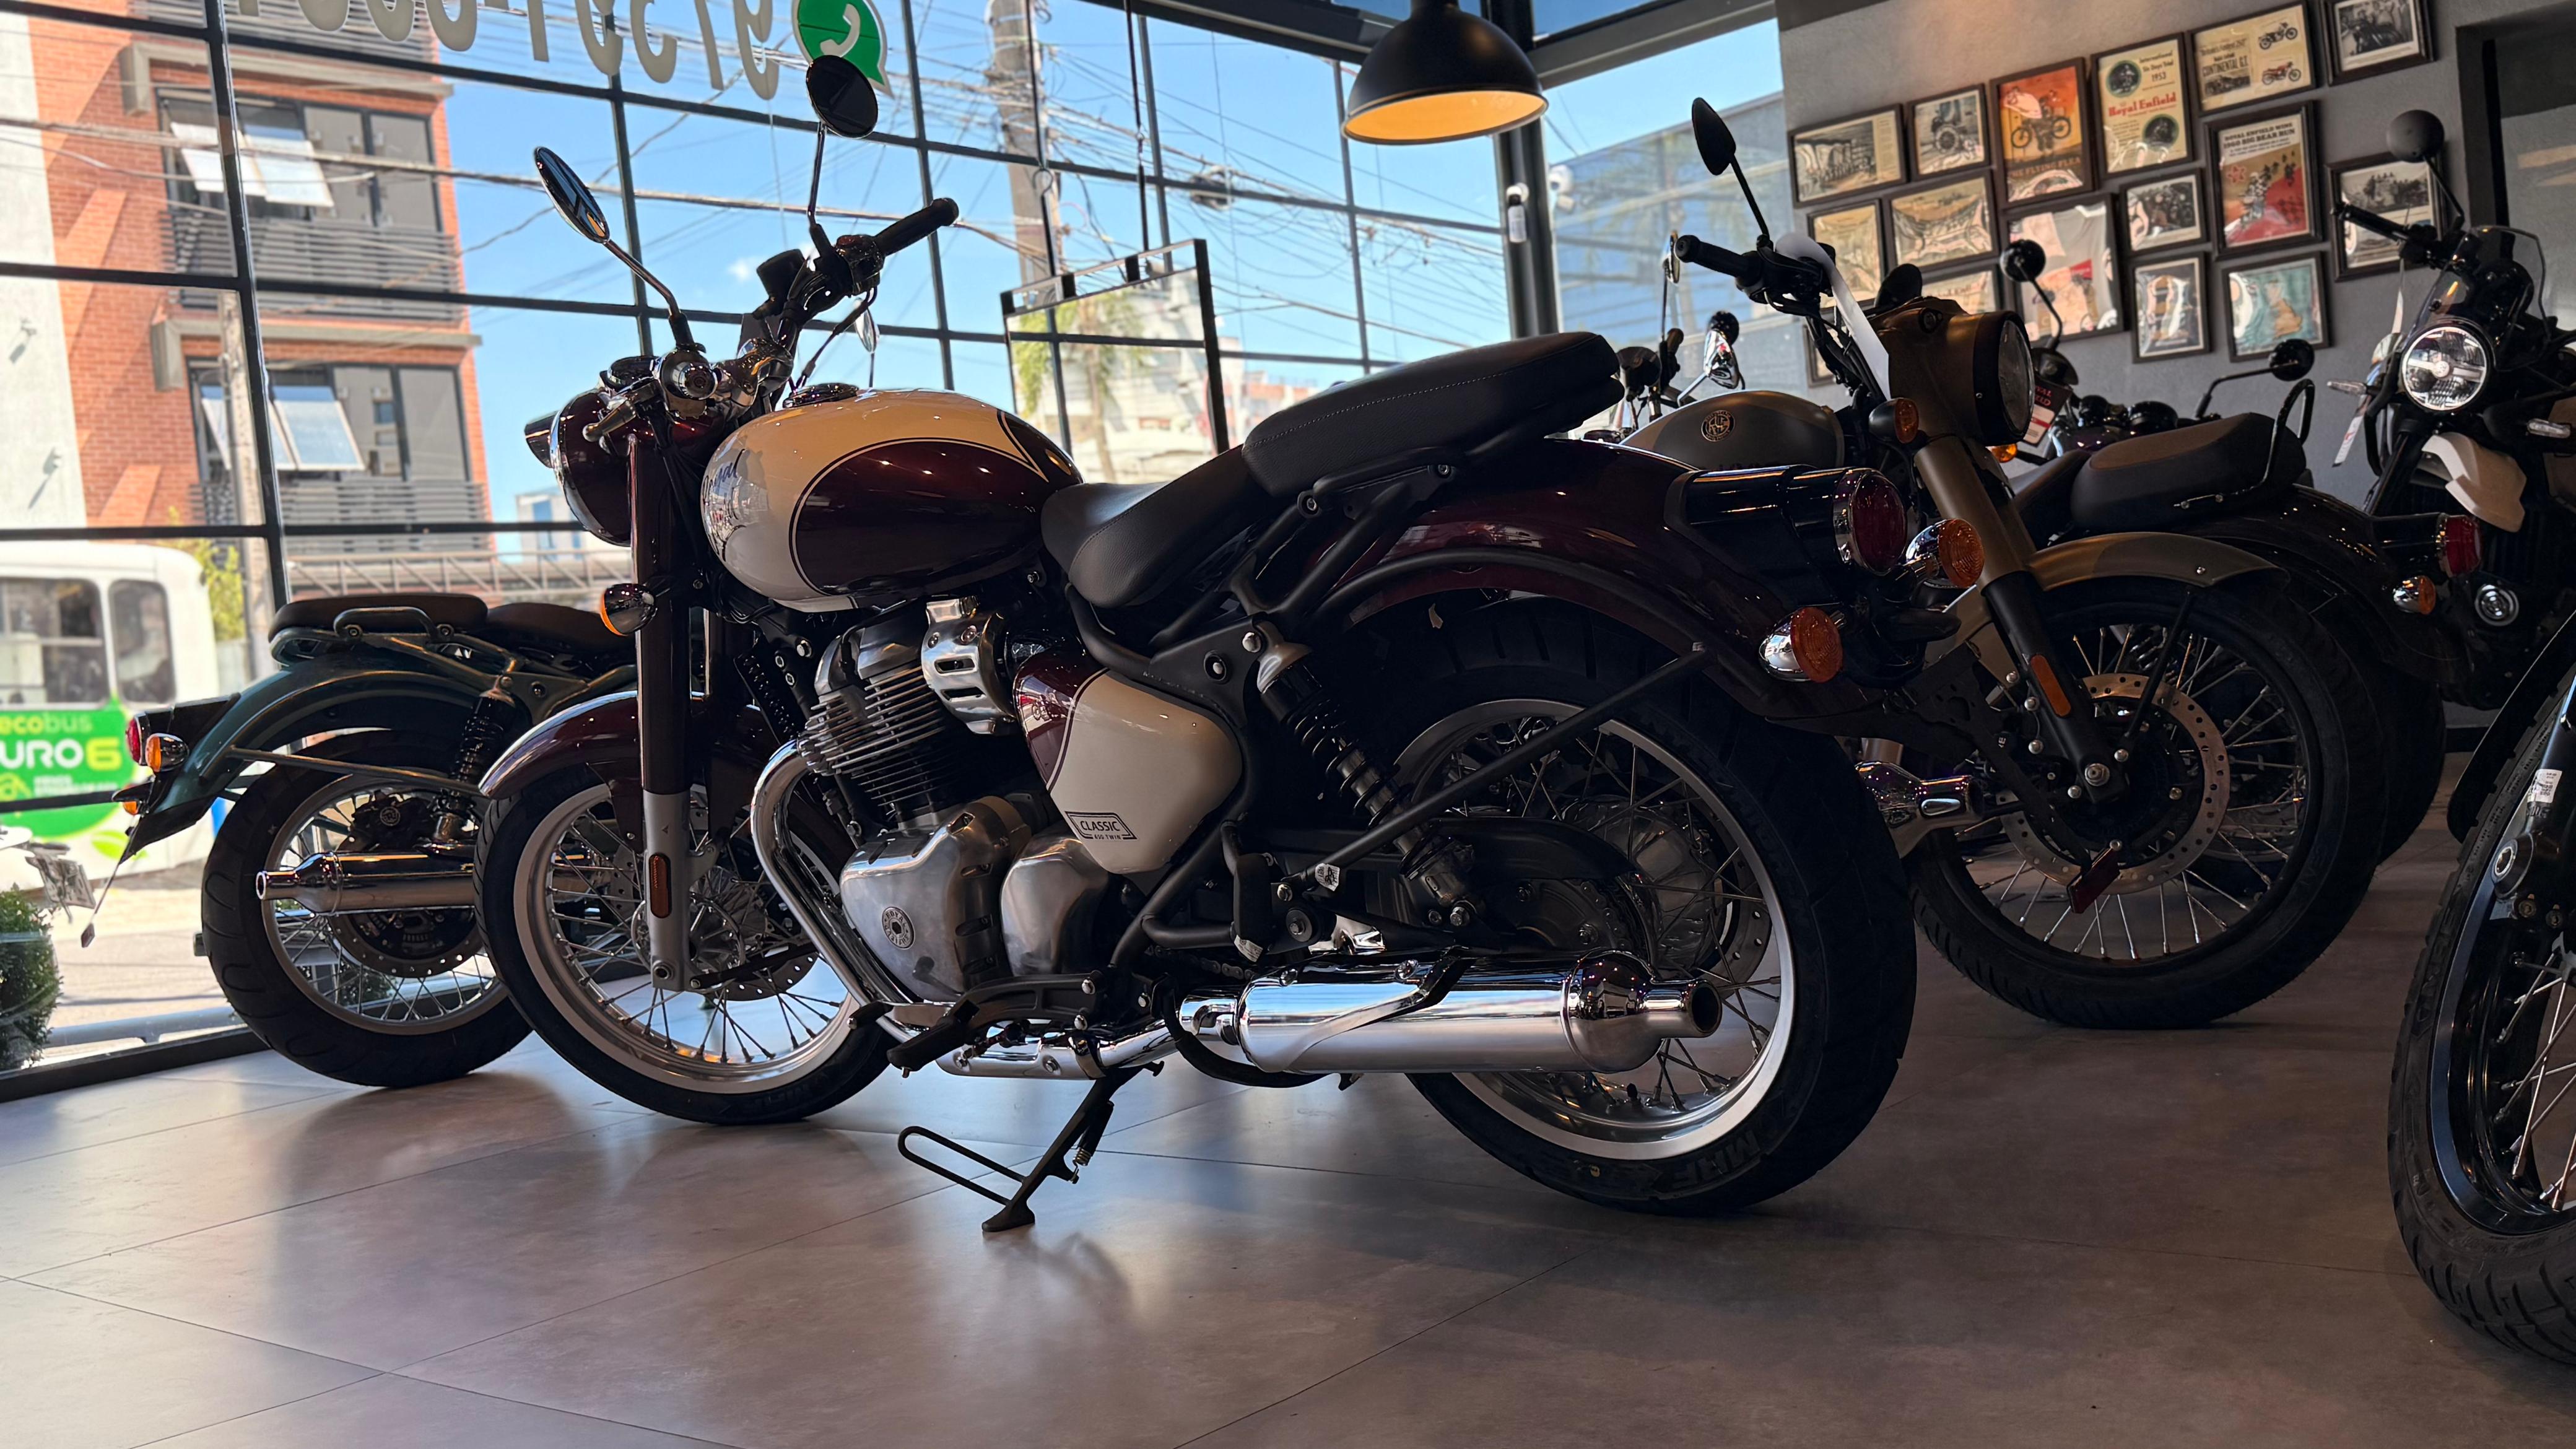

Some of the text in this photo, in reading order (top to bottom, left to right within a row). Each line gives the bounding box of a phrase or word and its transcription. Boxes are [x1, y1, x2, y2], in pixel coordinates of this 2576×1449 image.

[2151, 71, 2167, 82] 1953
[2108, 101, 2136, 117] Royal
[2139, 92, 2177, 110] Enfield
[0, 711, 92, 736] ecobus
[1080, 820, 1120, 831] CLASSIC
[886, 910, 907, 928] ROYAL
